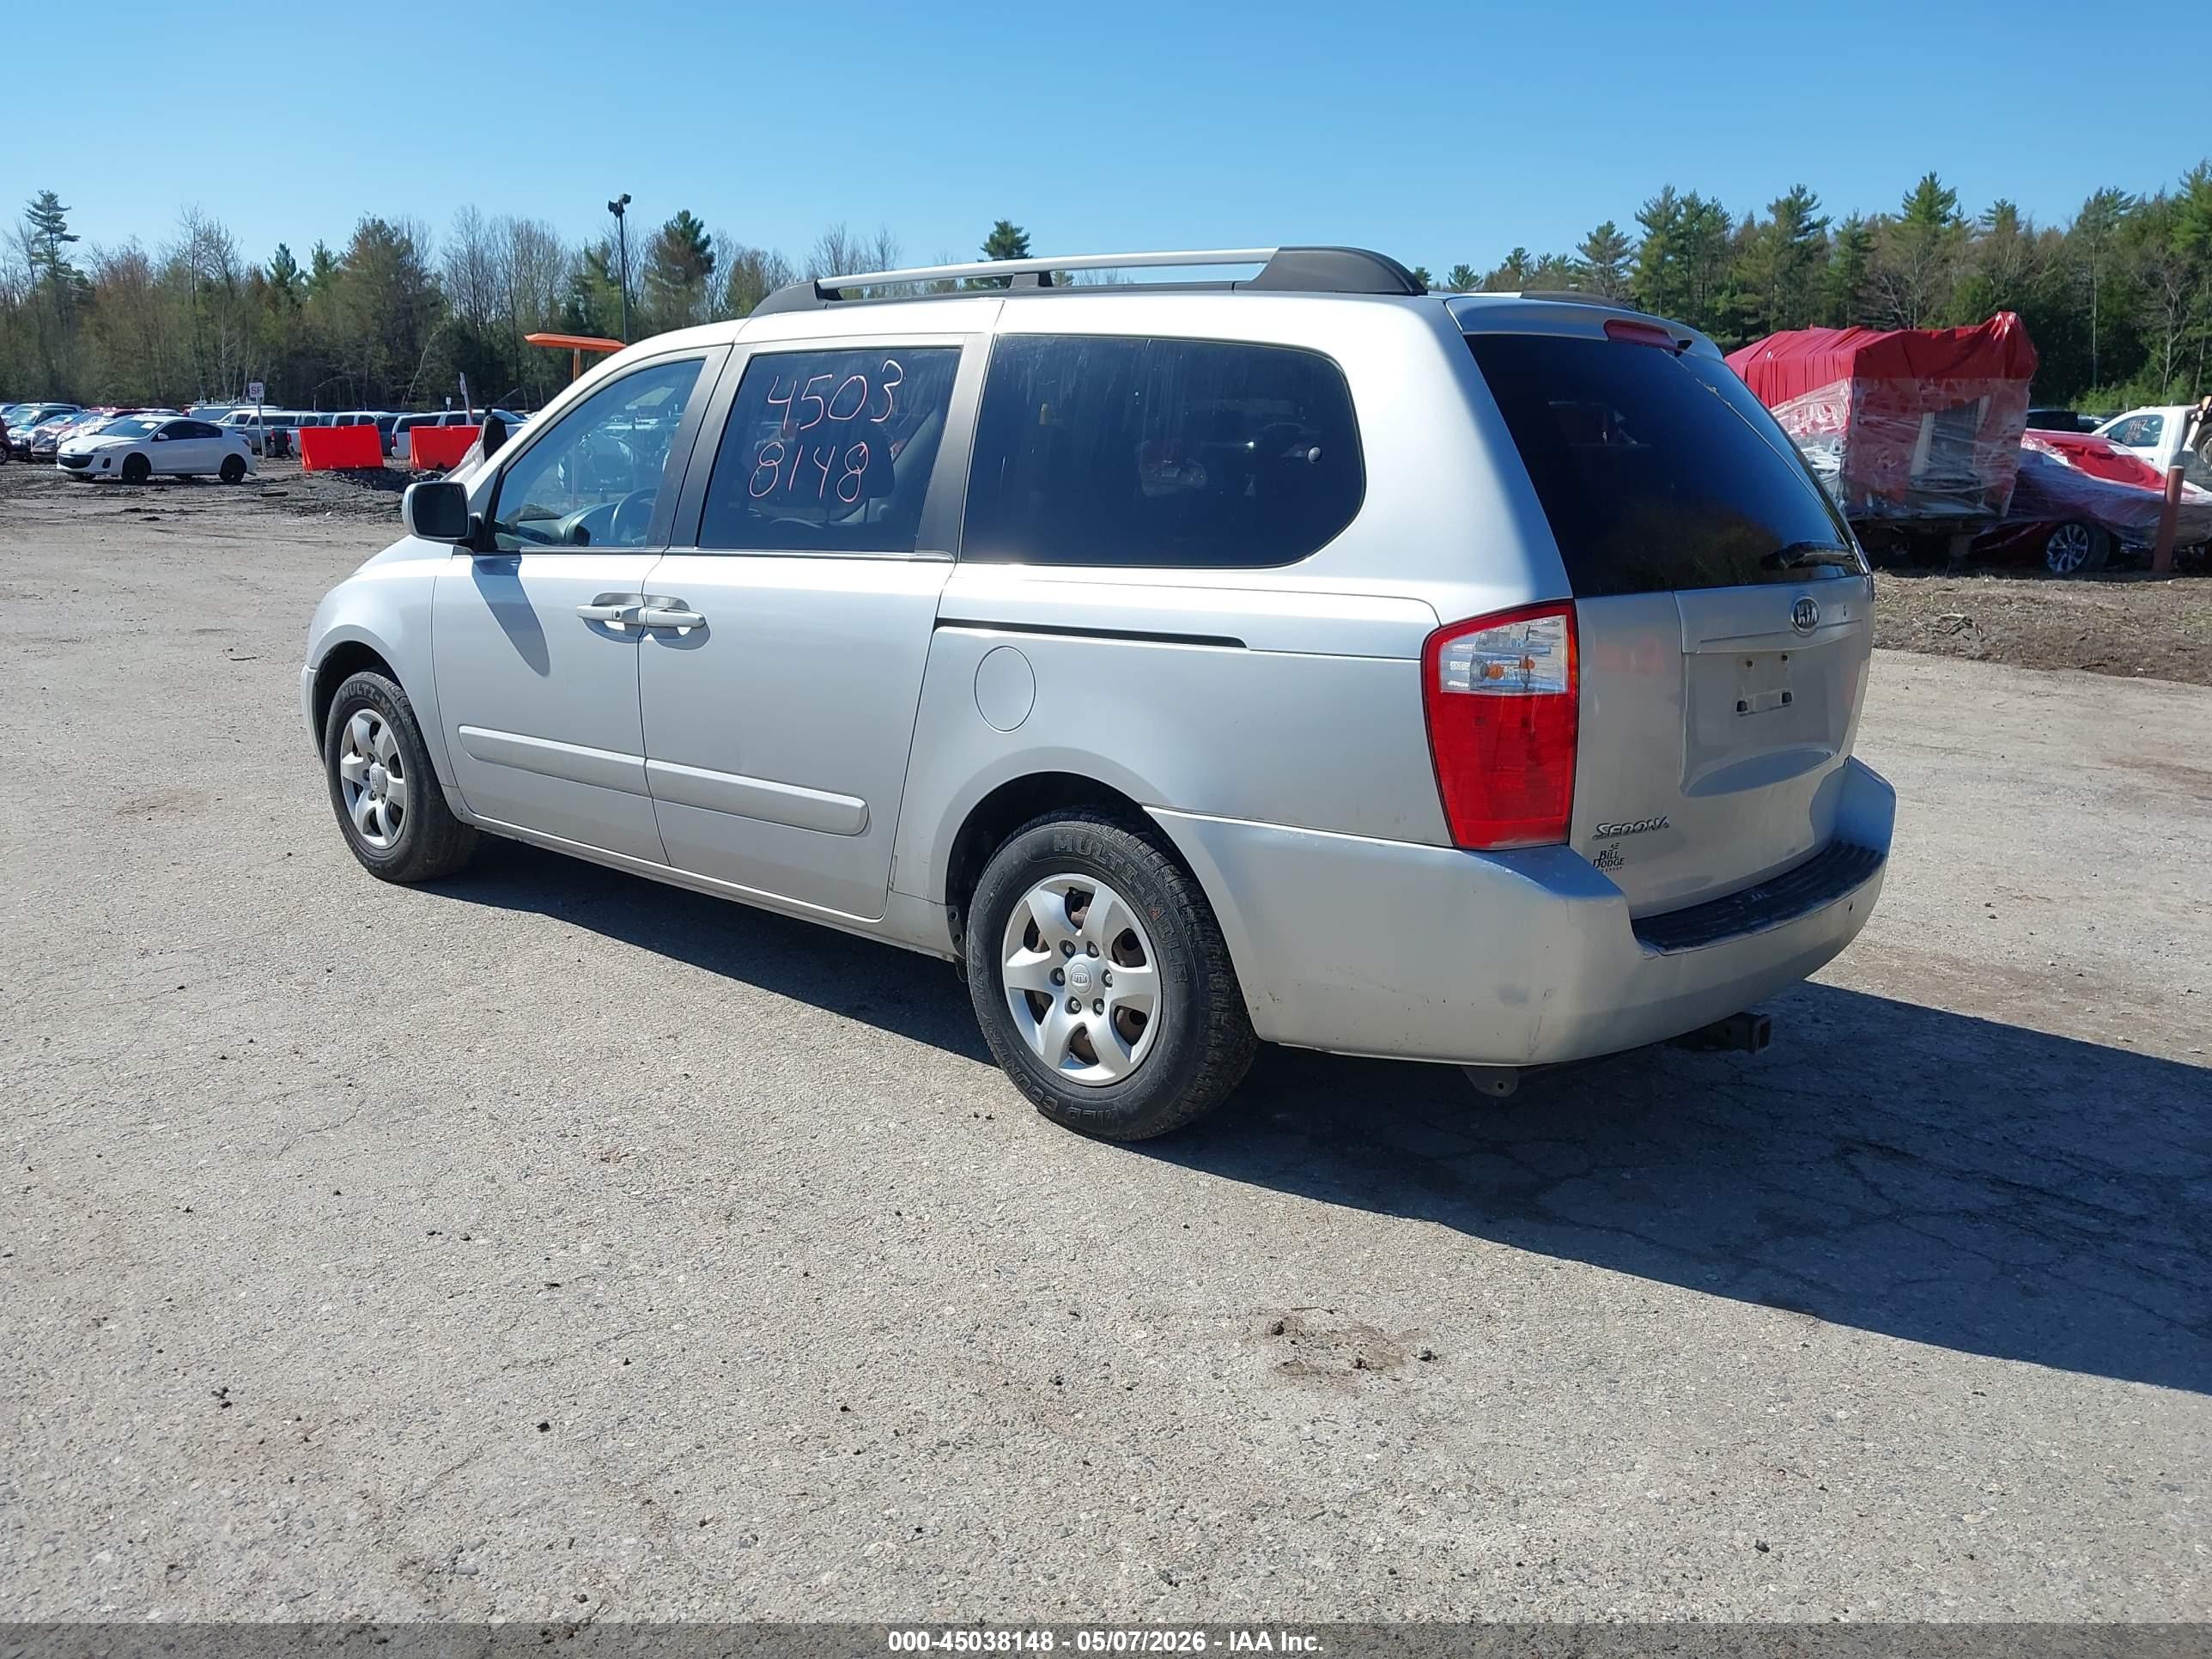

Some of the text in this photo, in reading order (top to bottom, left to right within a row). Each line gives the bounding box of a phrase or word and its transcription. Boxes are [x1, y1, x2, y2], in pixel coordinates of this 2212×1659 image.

[768, 359, 903, 430] 4503
[749, 441, 869, 502] 8148
[1592, 816, 1670, 840] SEDONA
[1593, 857, 1626, 868] DODGE
[1600, 850, 1619, 860] BILL
